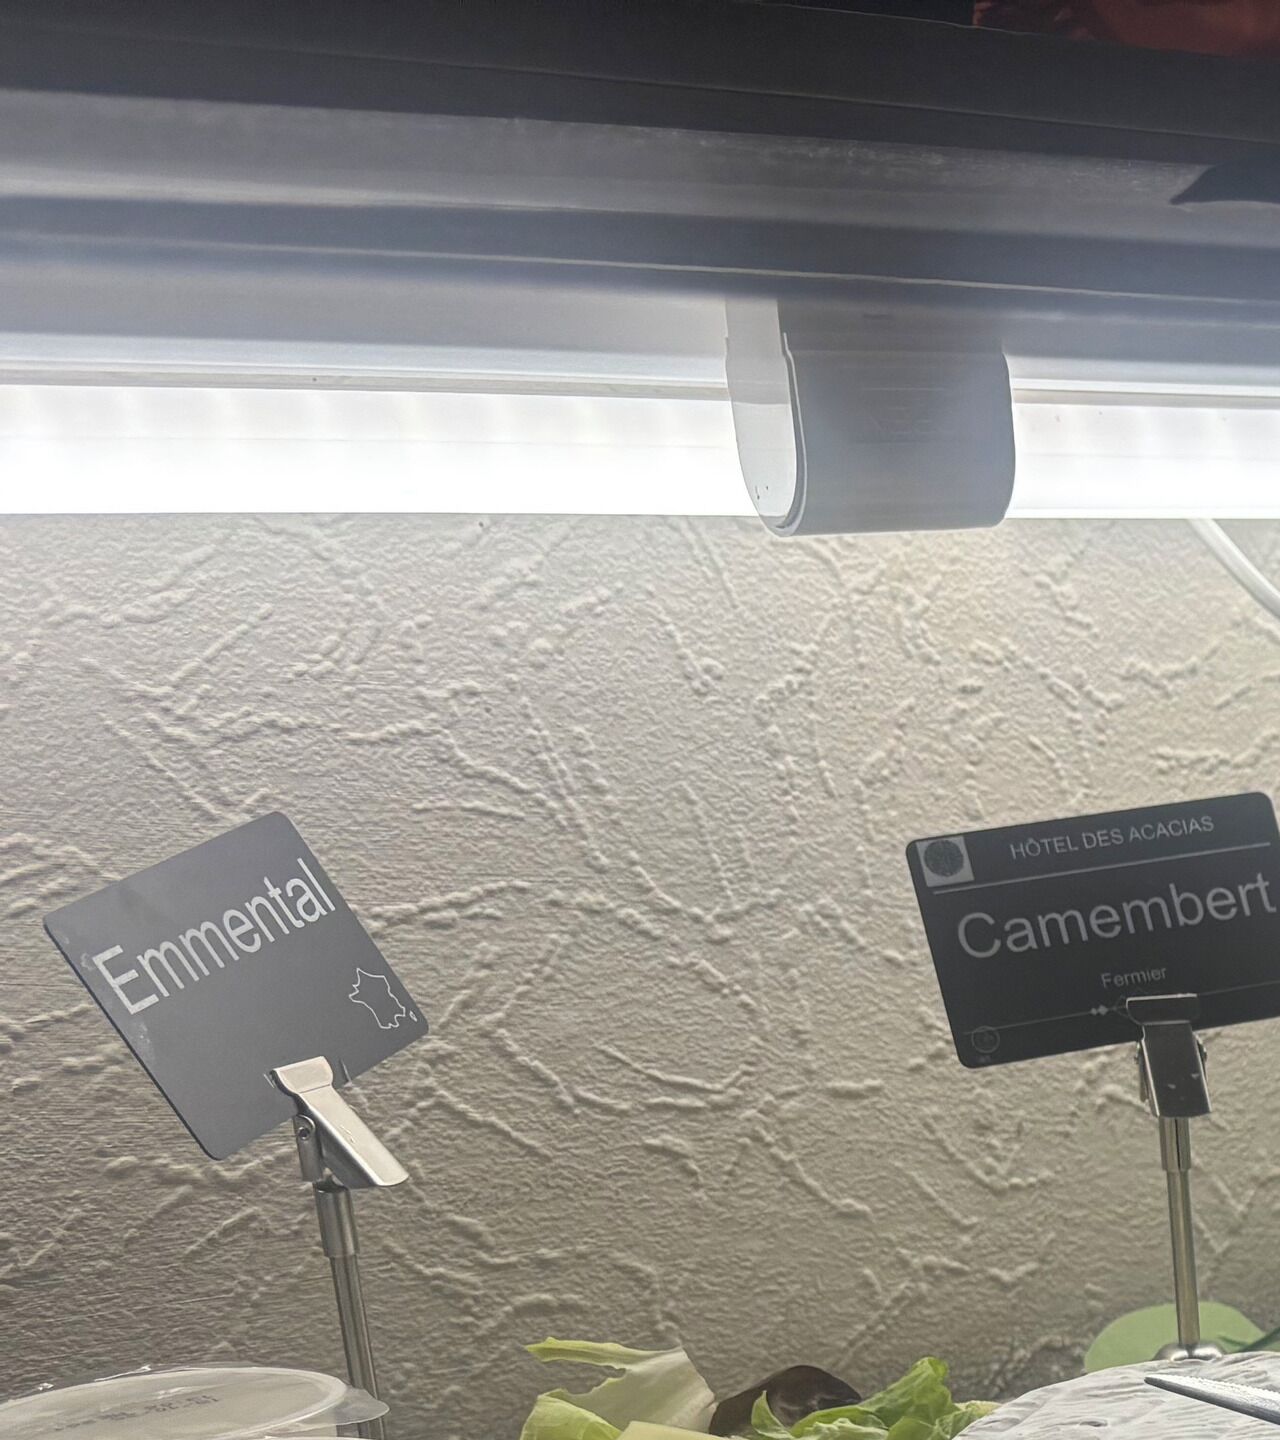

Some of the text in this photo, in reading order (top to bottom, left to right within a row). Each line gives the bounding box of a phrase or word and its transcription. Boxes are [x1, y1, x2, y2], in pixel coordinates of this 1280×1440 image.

[1010, 816, 1215, 860] HÔTEL DES ACACIAS
[92, 857, 336, 1015] Emmental
[957, 872, 1277, 959] Camembert
[1101, 965, 1168, 989] Fermier
